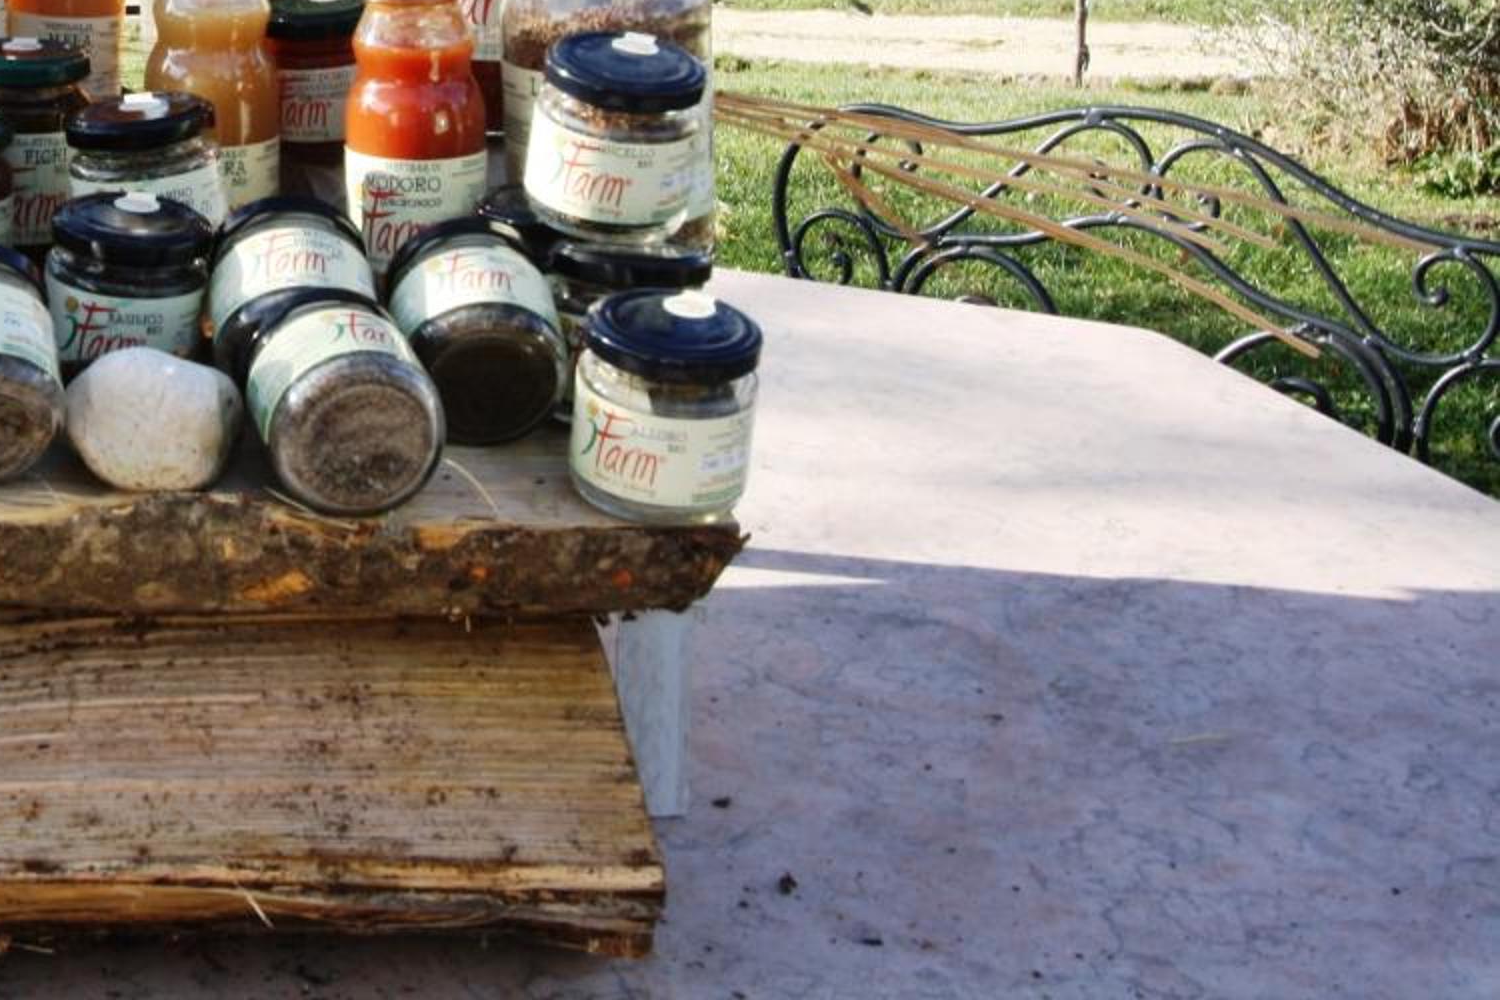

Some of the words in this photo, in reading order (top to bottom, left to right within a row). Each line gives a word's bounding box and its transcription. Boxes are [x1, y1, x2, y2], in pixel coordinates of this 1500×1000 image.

[282, 101, 328, 129] arm
[563, 140, 625, 207] Farm
[596, 409, 658, 487] Farm
